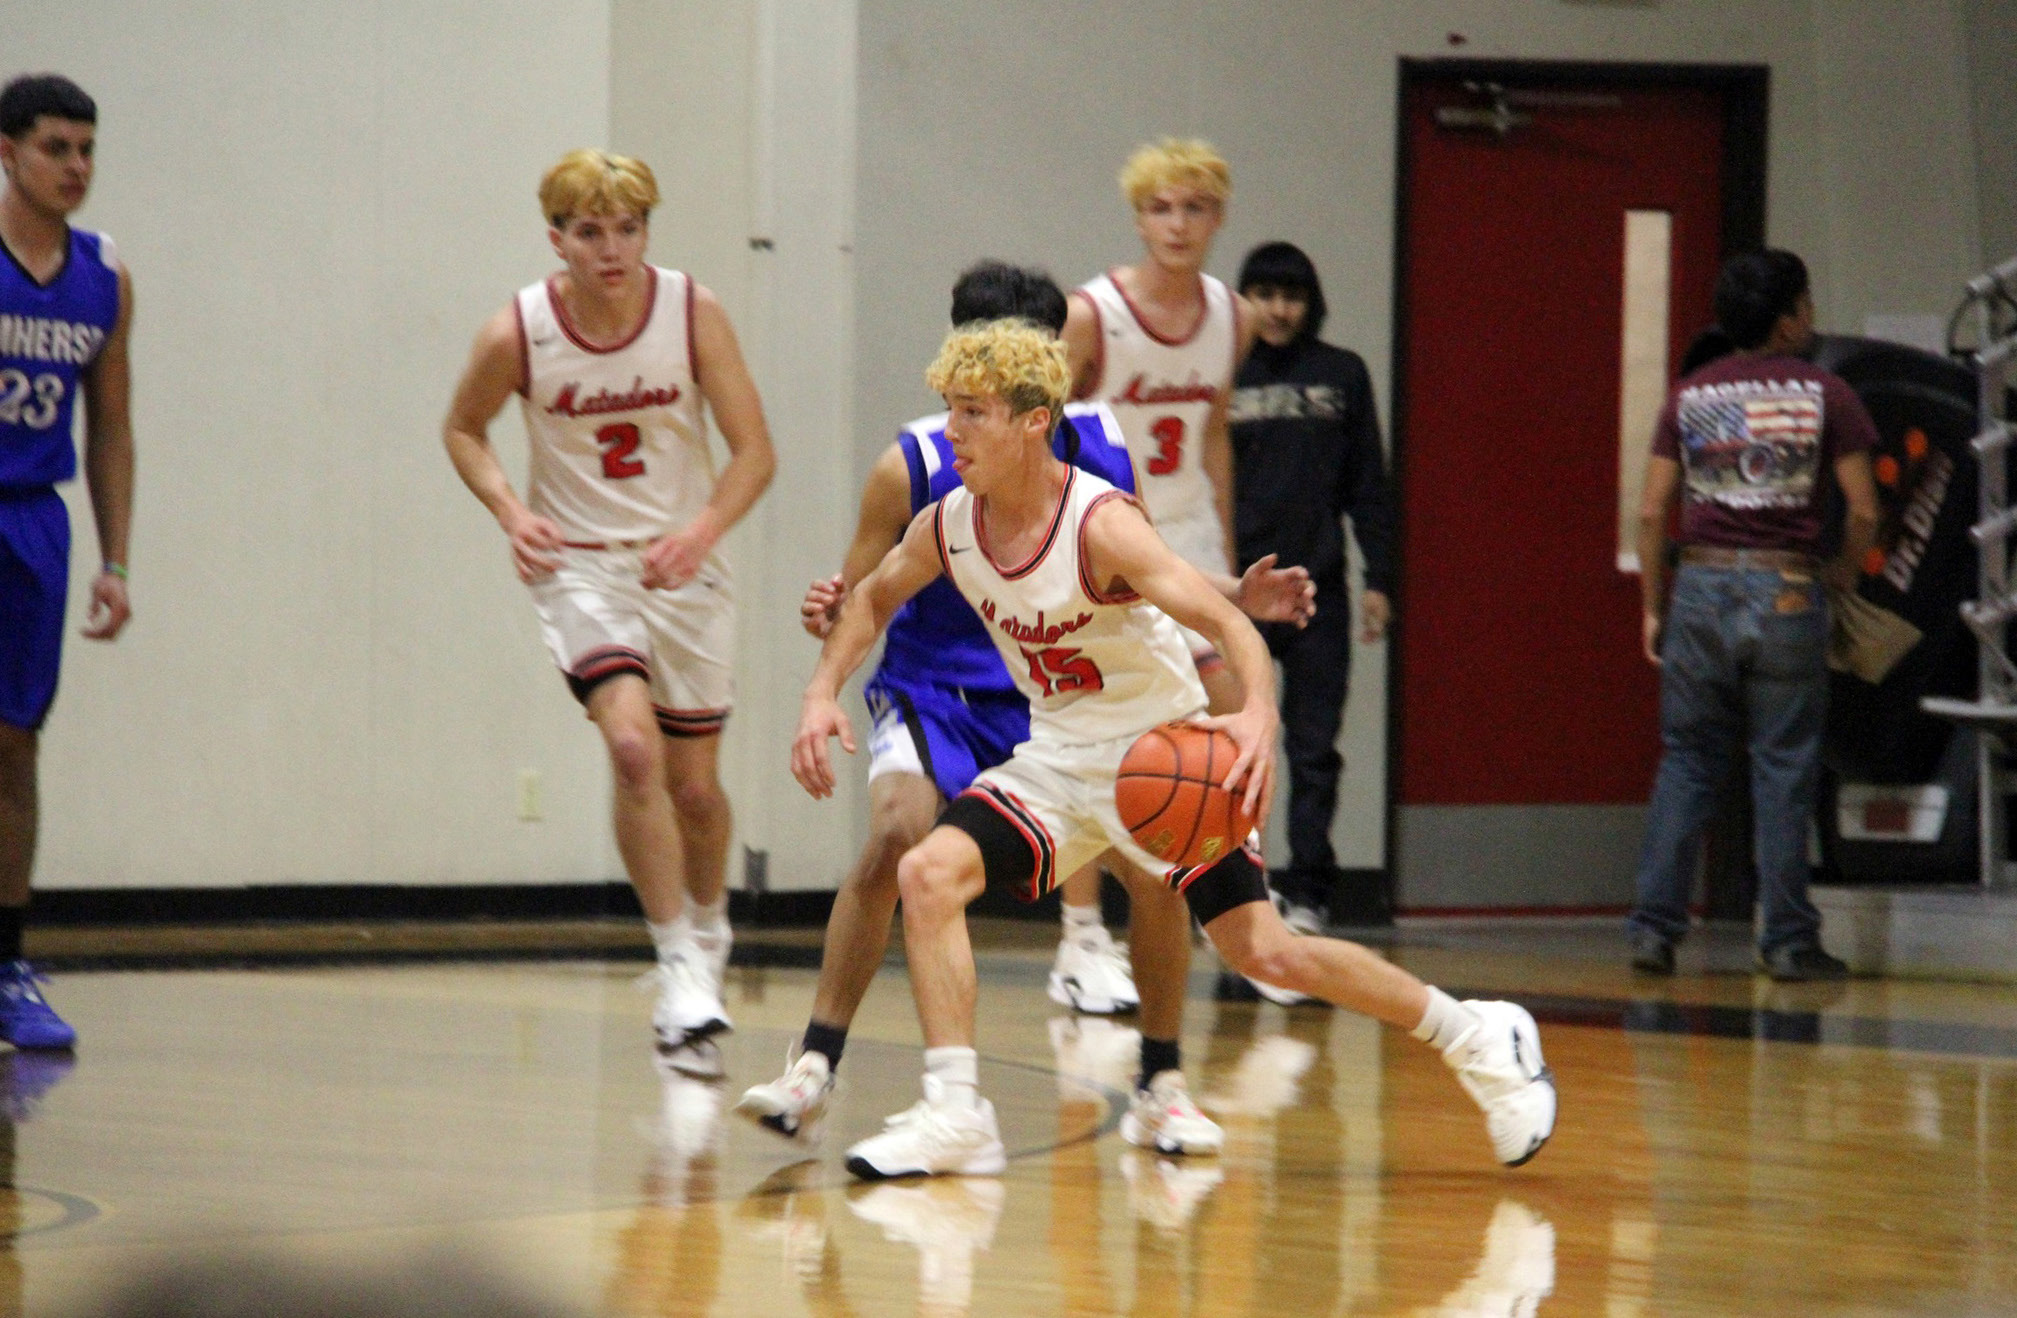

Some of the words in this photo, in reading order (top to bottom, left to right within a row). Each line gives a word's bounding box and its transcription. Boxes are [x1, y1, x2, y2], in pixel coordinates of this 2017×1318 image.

[0, 368, 64, 430] 23
[595, 421, 646, 479] 2
[1147, 416, 1185, 476] 3
[1019, 646, 1104, 698] 15
